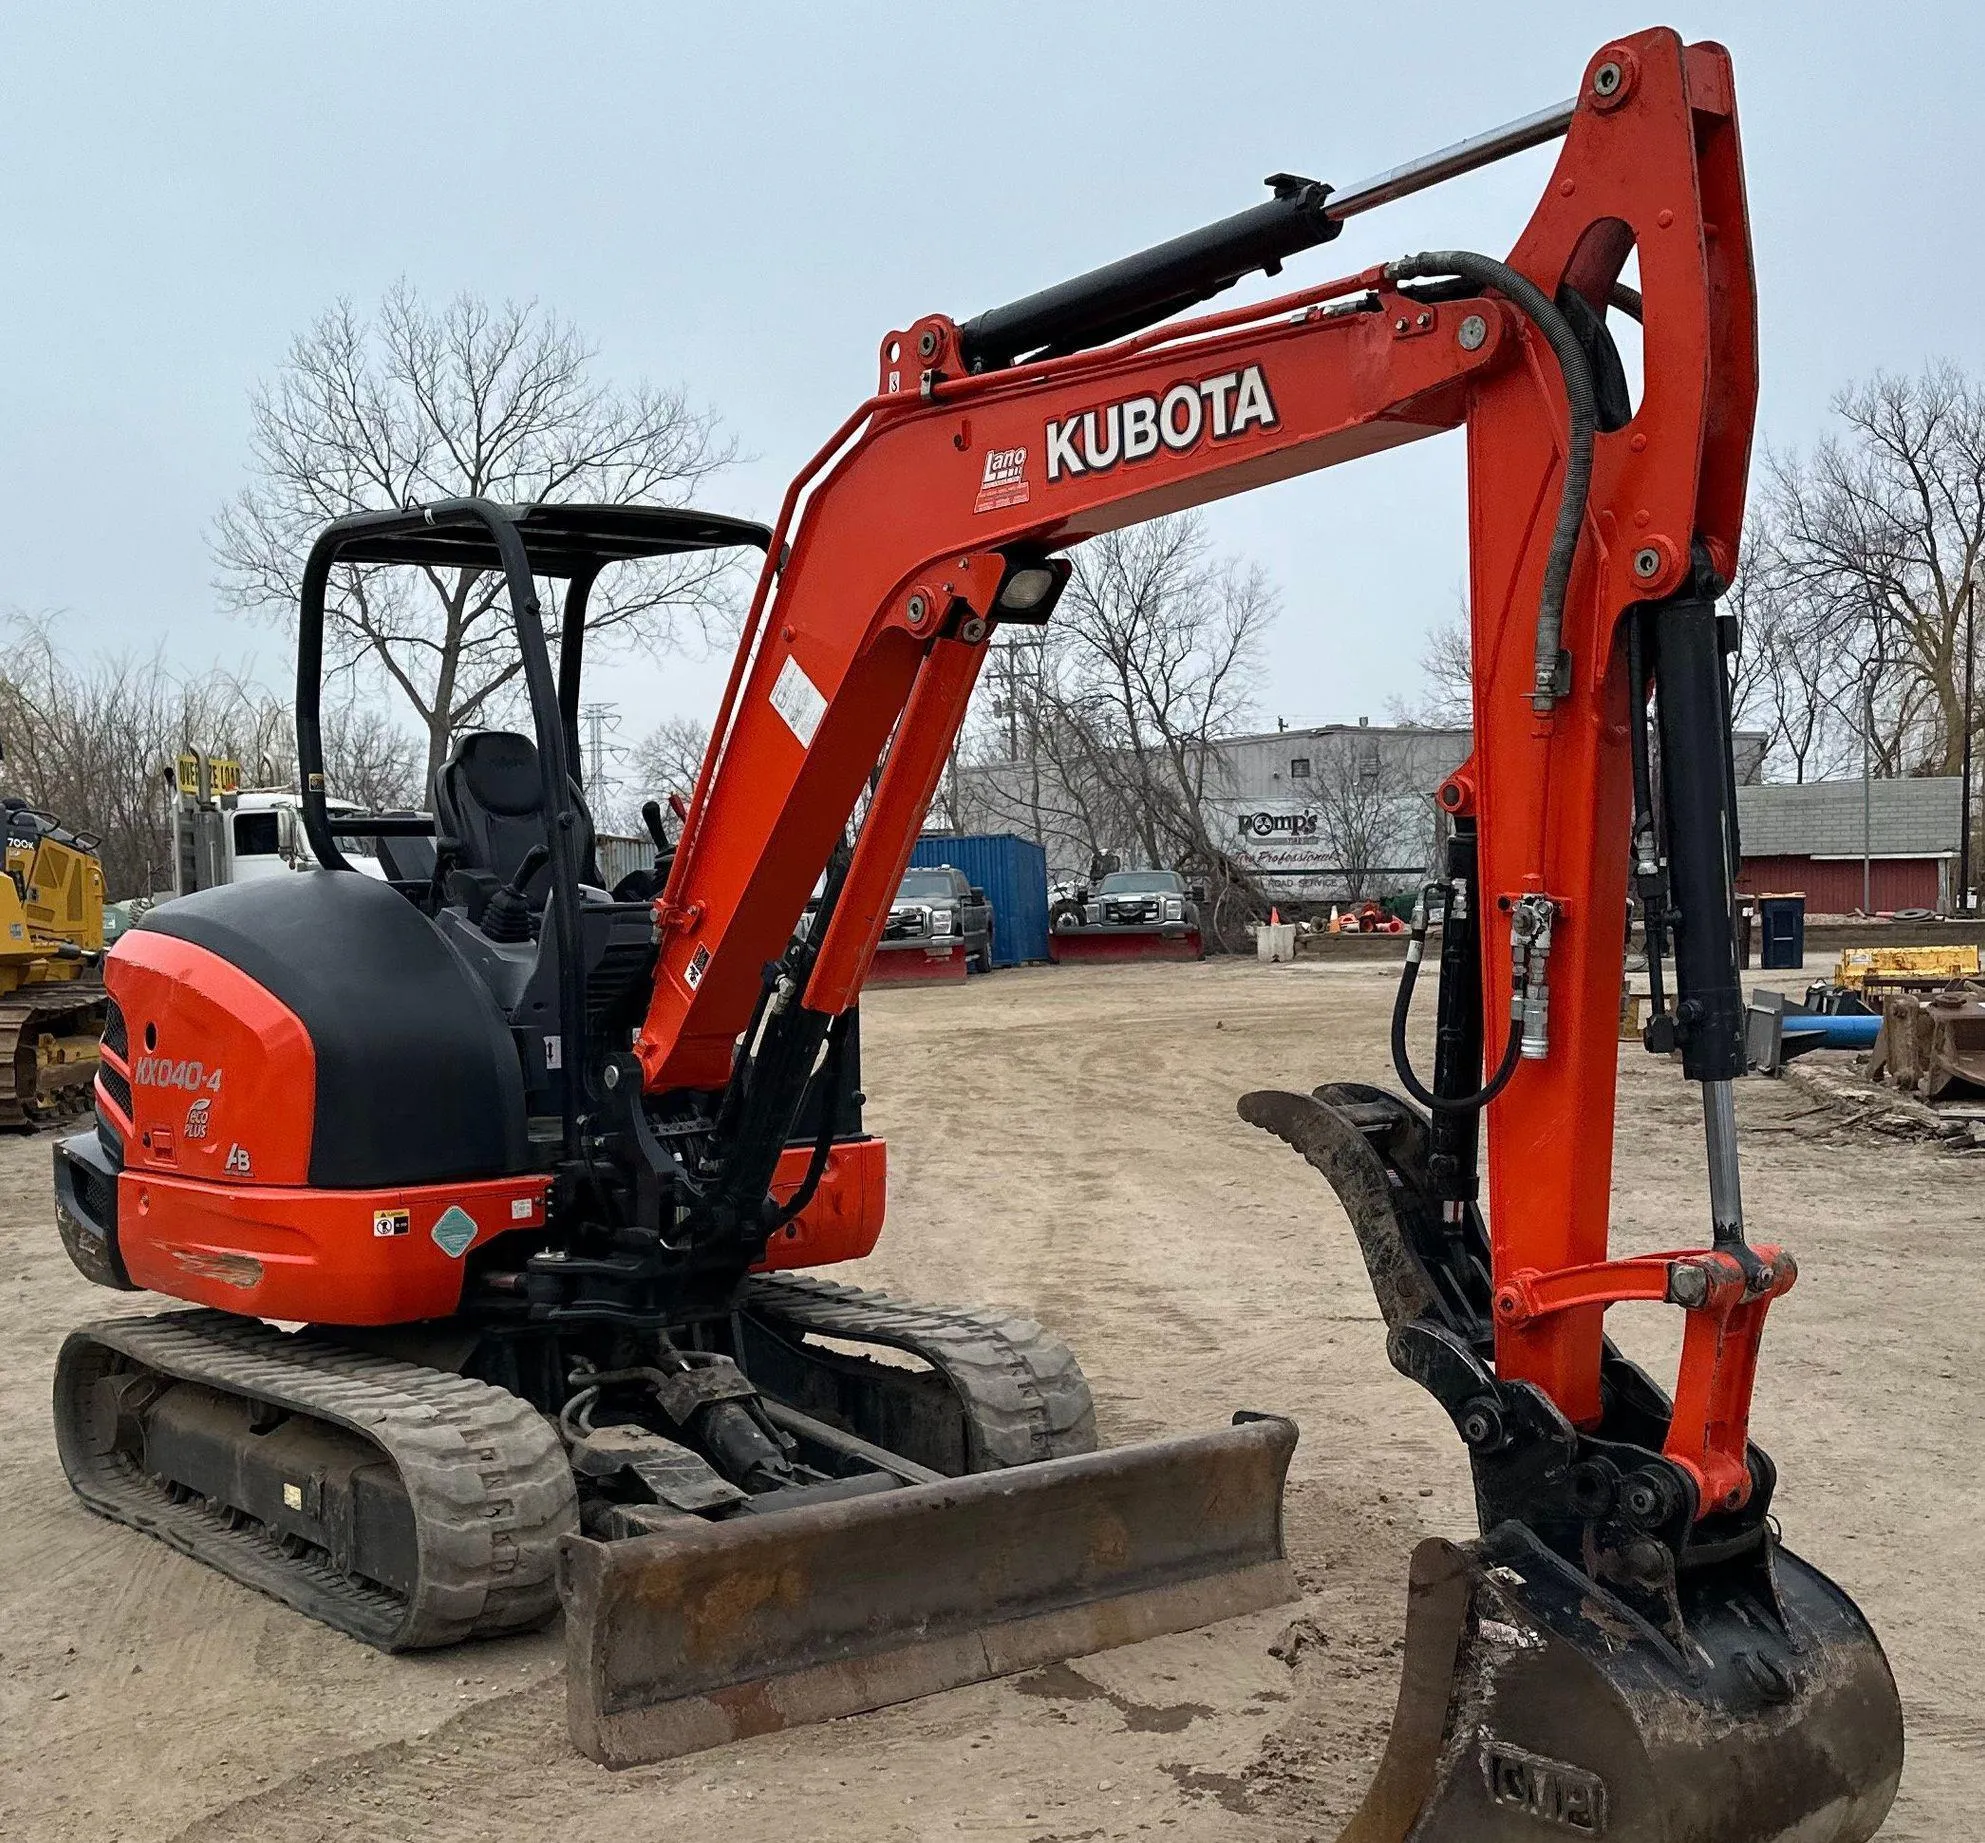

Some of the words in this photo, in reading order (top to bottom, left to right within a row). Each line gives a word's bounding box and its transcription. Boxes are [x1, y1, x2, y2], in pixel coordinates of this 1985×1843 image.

[1045, 365, 1276, 480] KUBOTA
[179, 759, 218, 788] OVERE
[7, 837, 35, 851] 700K
